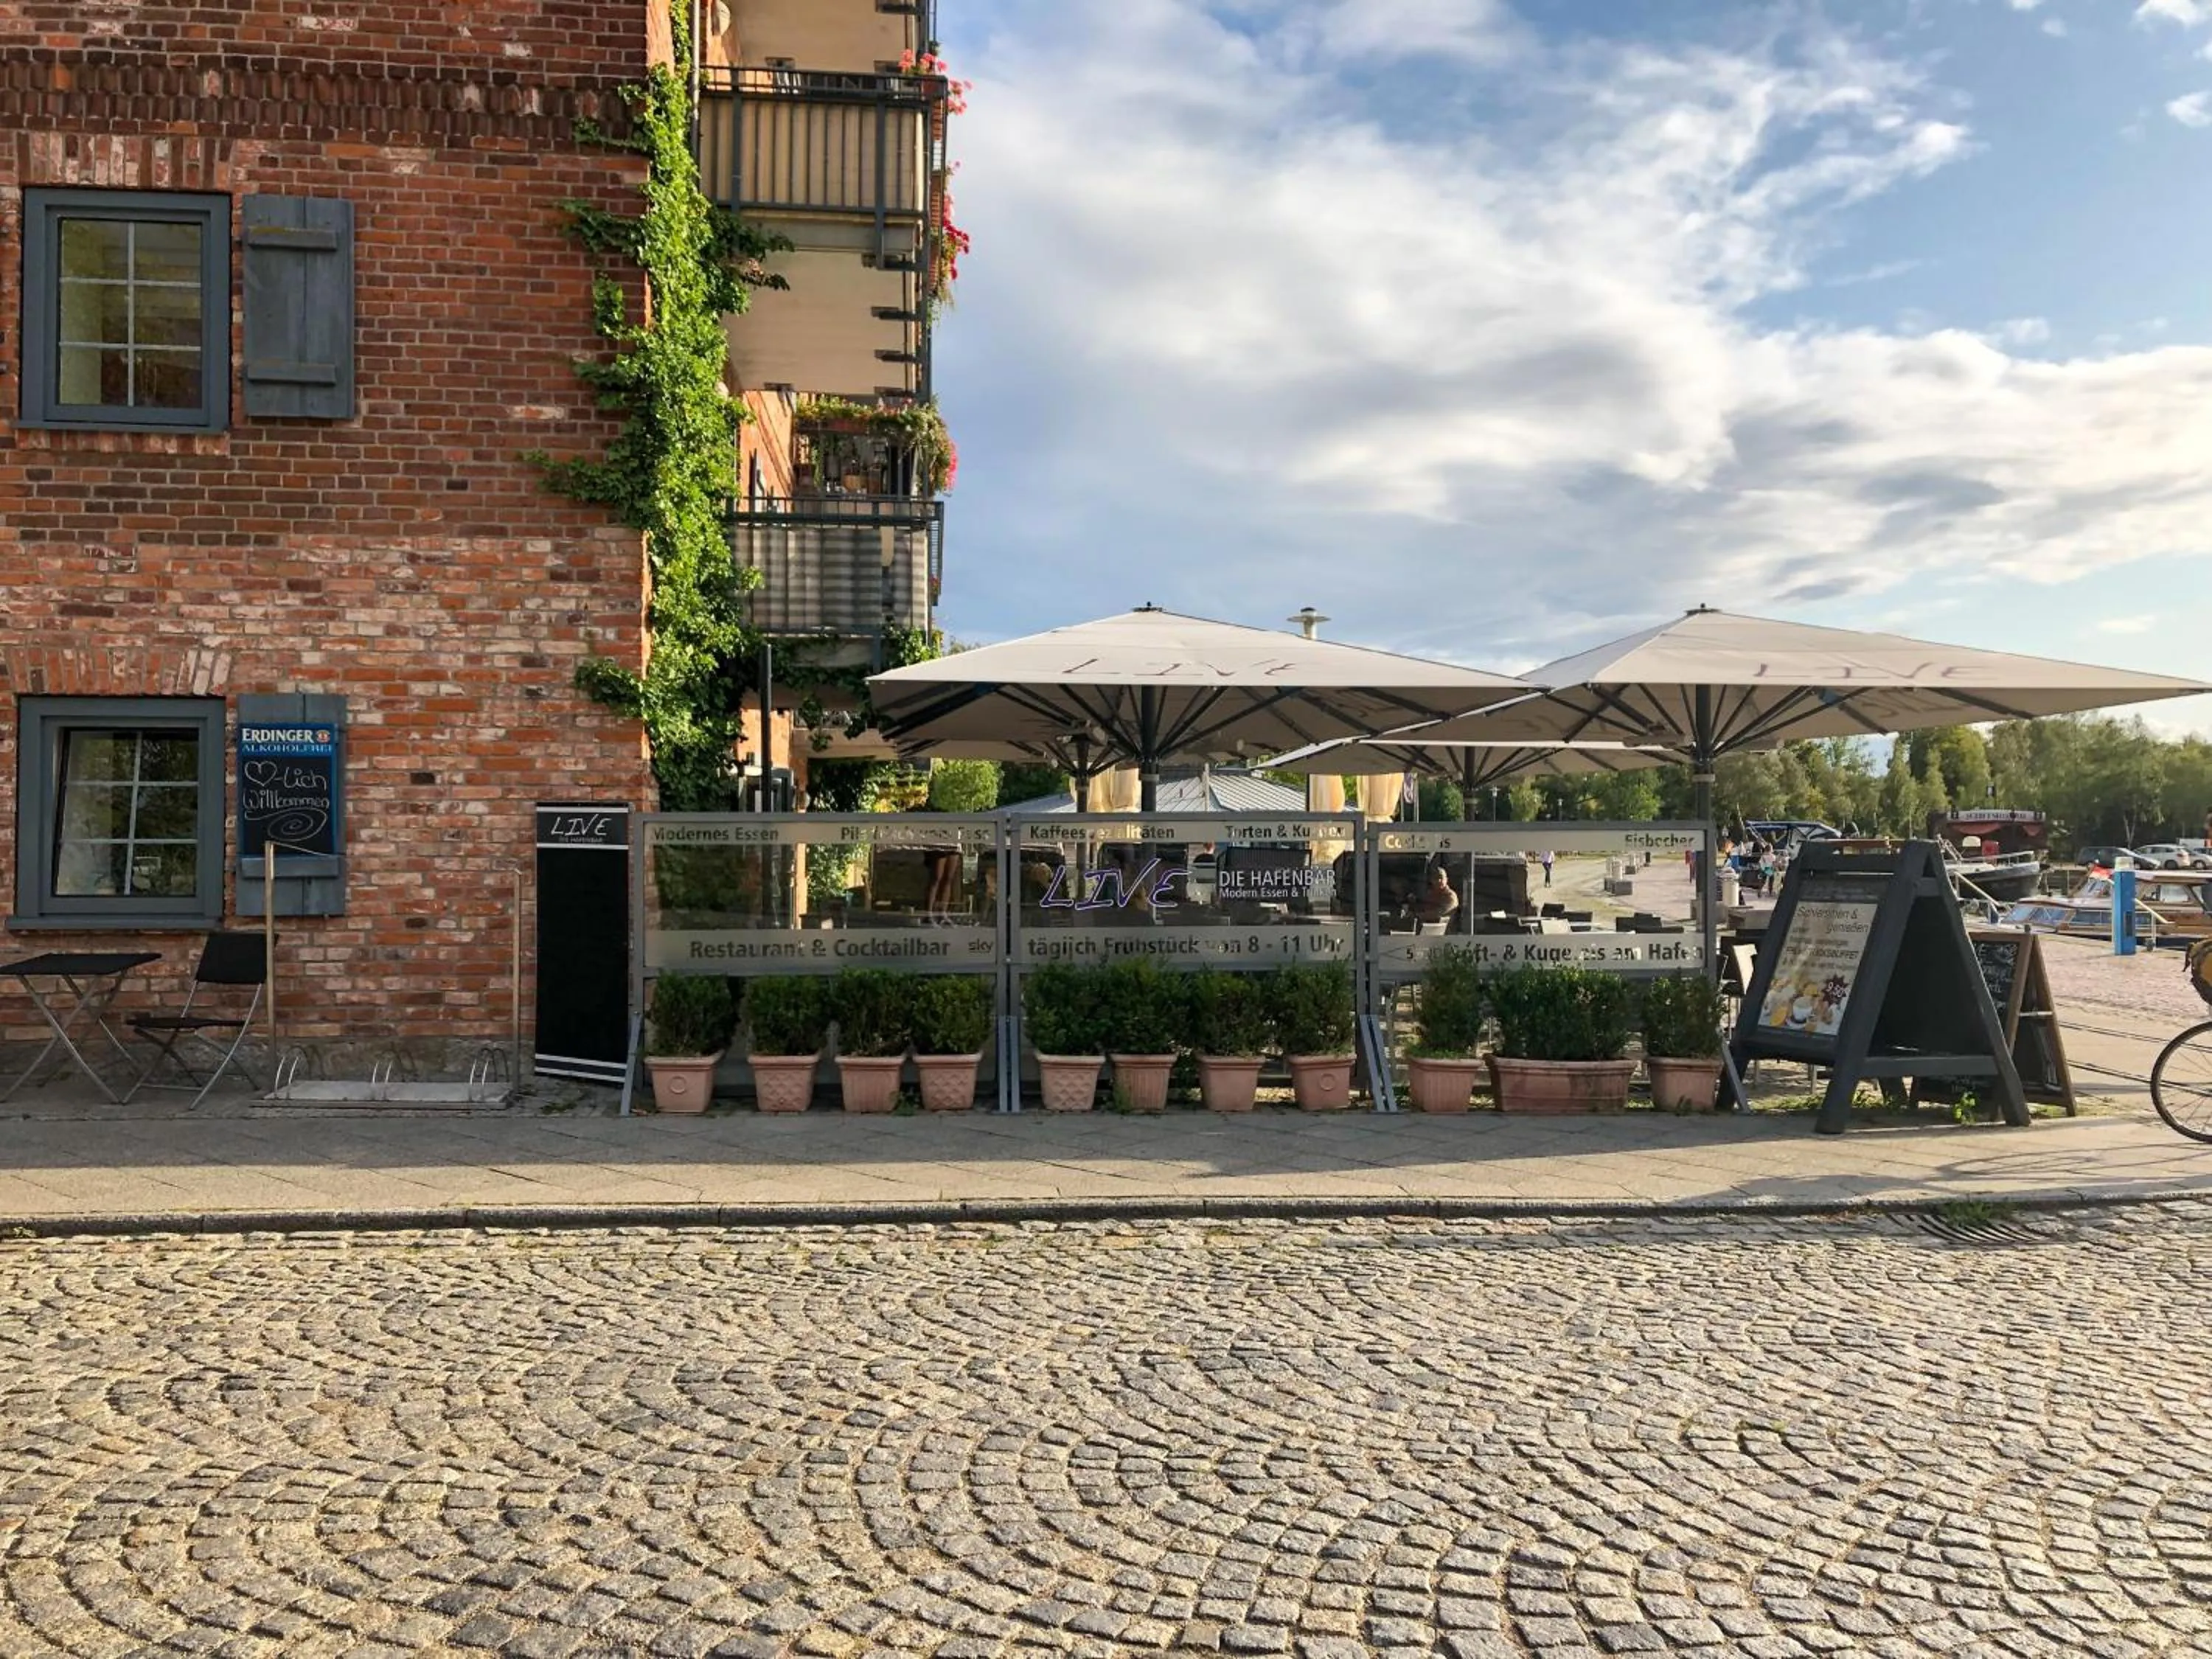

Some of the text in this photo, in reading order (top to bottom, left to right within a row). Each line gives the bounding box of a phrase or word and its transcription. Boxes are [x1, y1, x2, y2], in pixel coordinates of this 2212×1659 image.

[242, 728, 315, 744] ERDINGER
[241, 744, 332, 753] ALKOHOLFREI
[243, 789, 330, 809] Willkommen
[551, 813, 613, 836] LIVE
[1277, 824, 1287, 838] &
[735, 827, 779, 841] Essen
[1040, 858, 1193, 911] LIVE
[1219, 869, 1336, 886] DIE HAFENBAR
[1219, 887, 1257, 898] Modern
[1261, 887, 1289, 897] Essen
[1291, 886, 1298, 897] &
[690, 938, 995, 958] Restaurant & Cocktailbar sky
[1248, 935, 1260, 953] 8
[1280, 934, 1300, 953] 11
[1310, 933, 1345, 953] Uhr
[1503, 944, 1517, 960] &
[1524, 944, 1605, 964] Kugeeis
